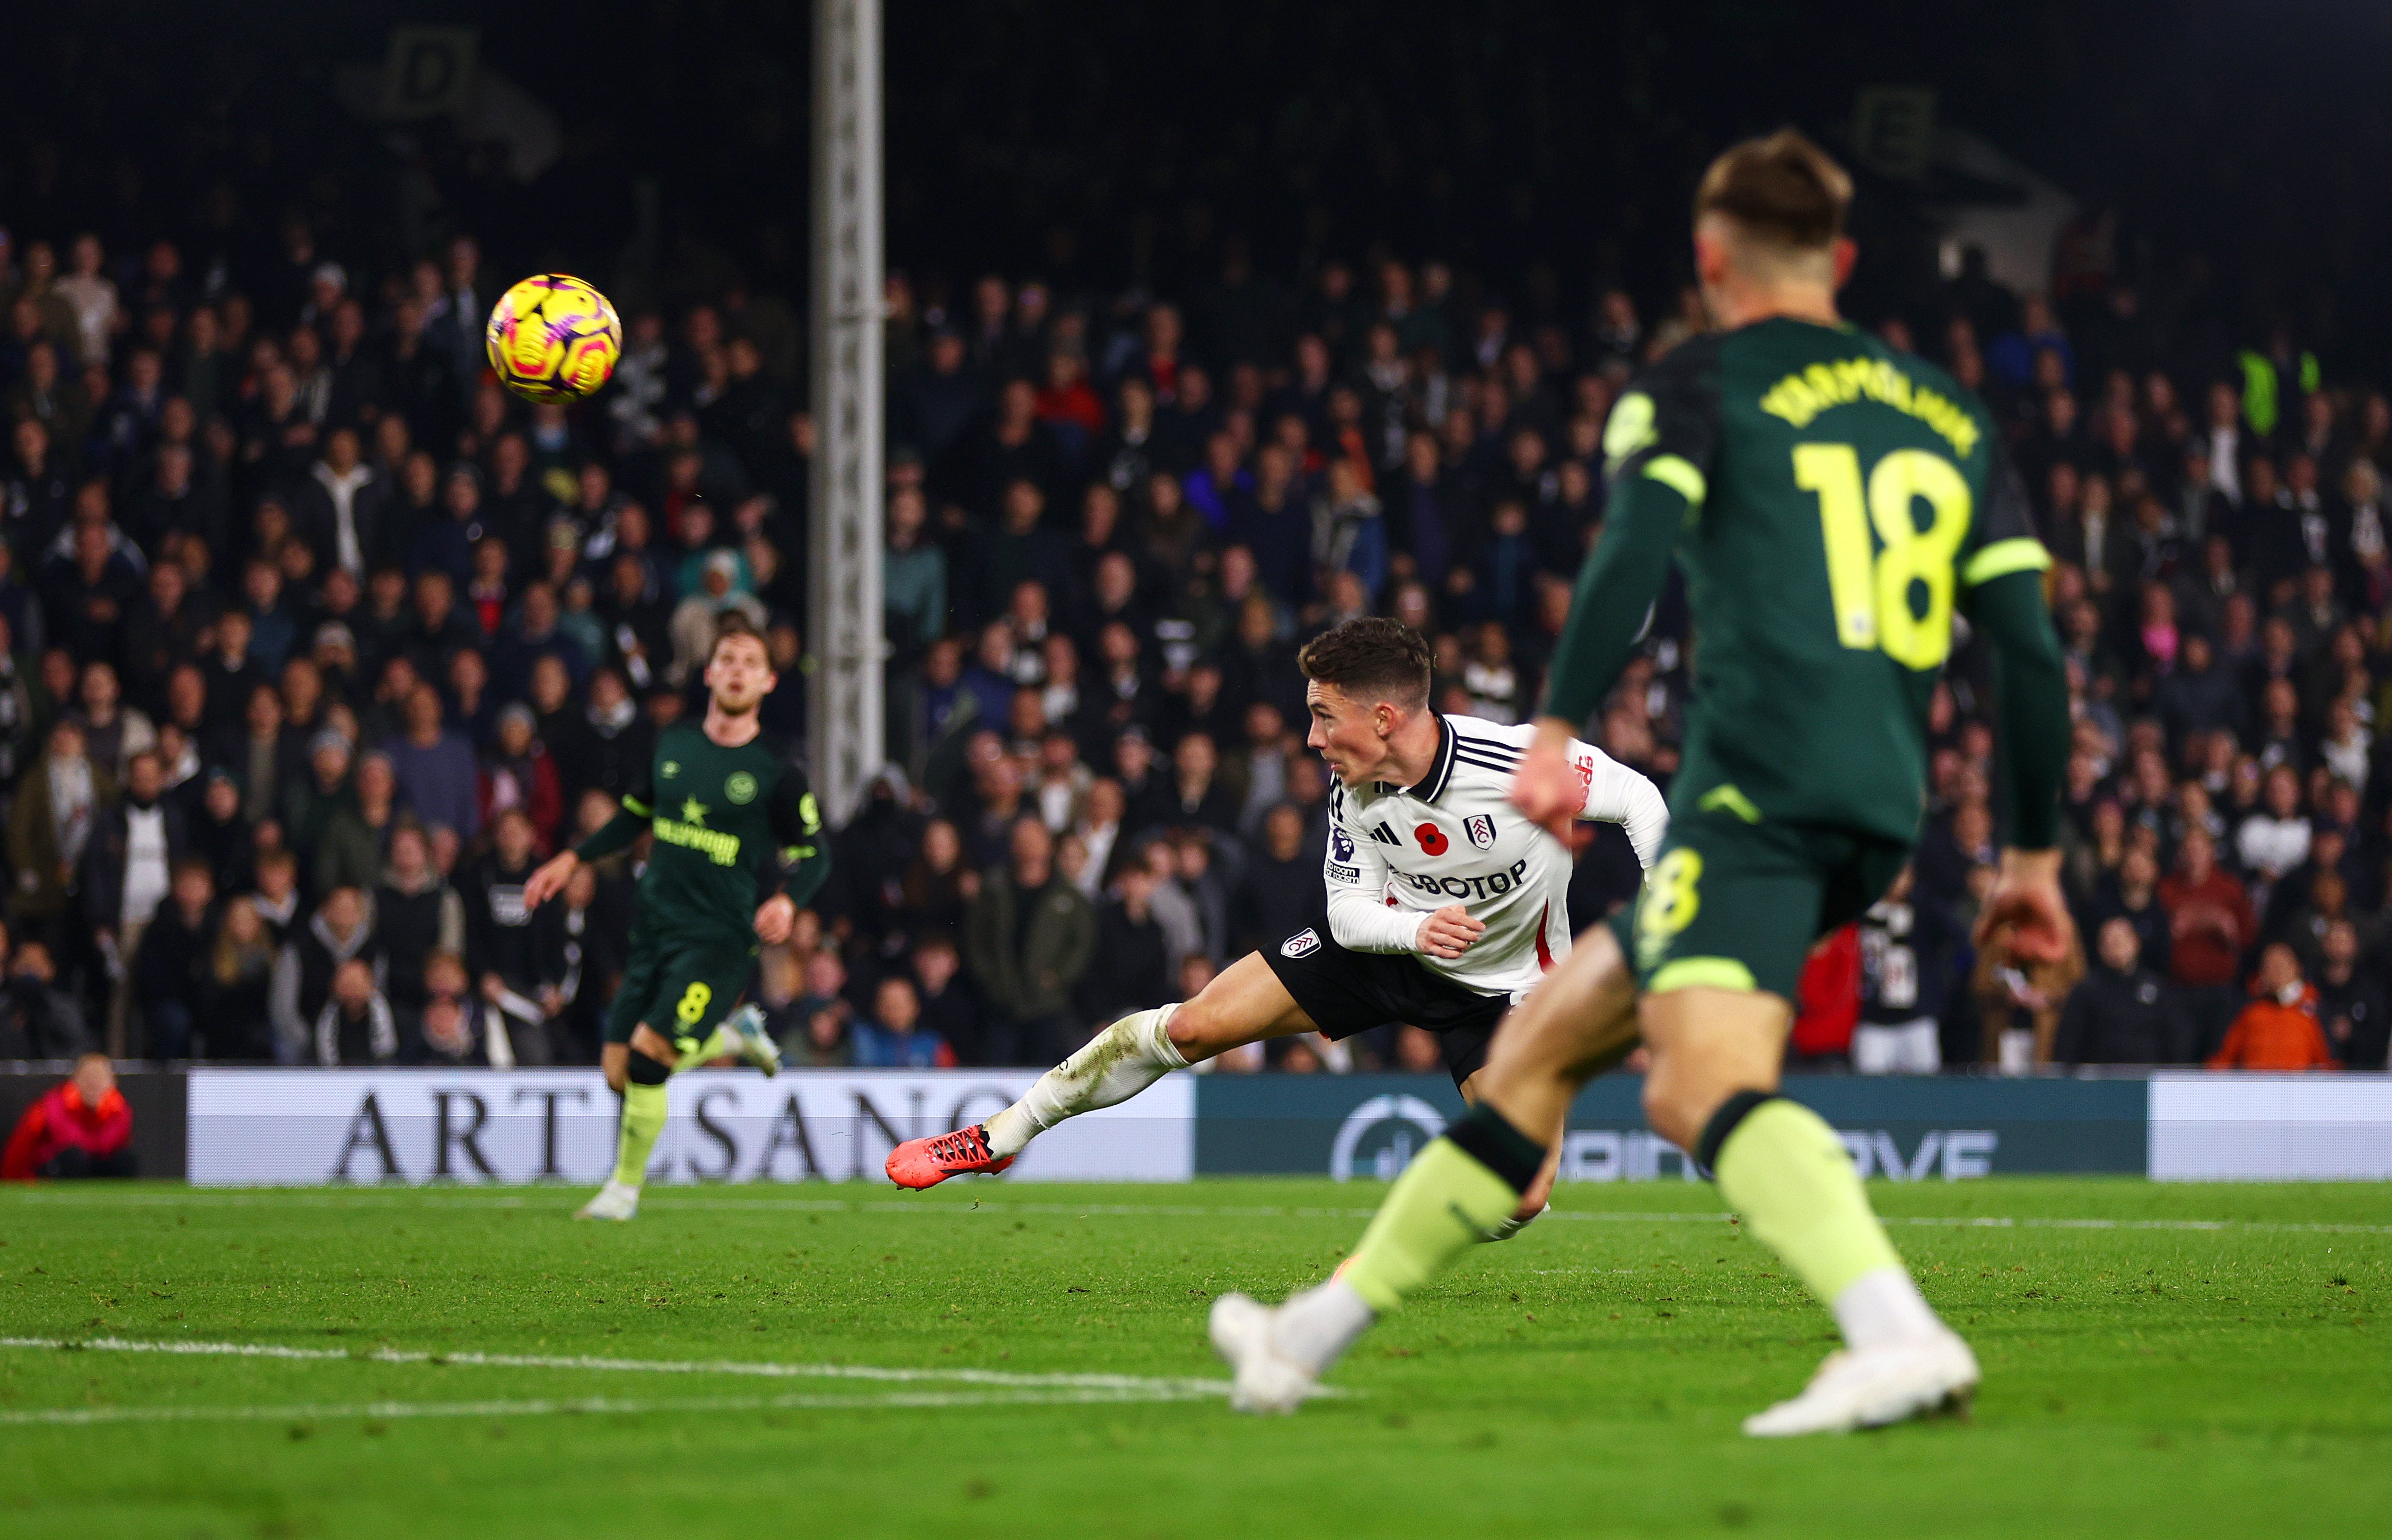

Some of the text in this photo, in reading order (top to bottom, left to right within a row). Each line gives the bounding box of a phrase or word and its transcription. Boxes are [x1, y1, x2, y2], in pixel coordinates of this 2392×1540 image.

[1791, 441, 1973, 673] 18
[1473, 819, 1489, 843] FFC
[1333, 872, 1360, 885] racism
[1334, 865, 1356, 877] room
[677, 981, 713, 1025] 8
